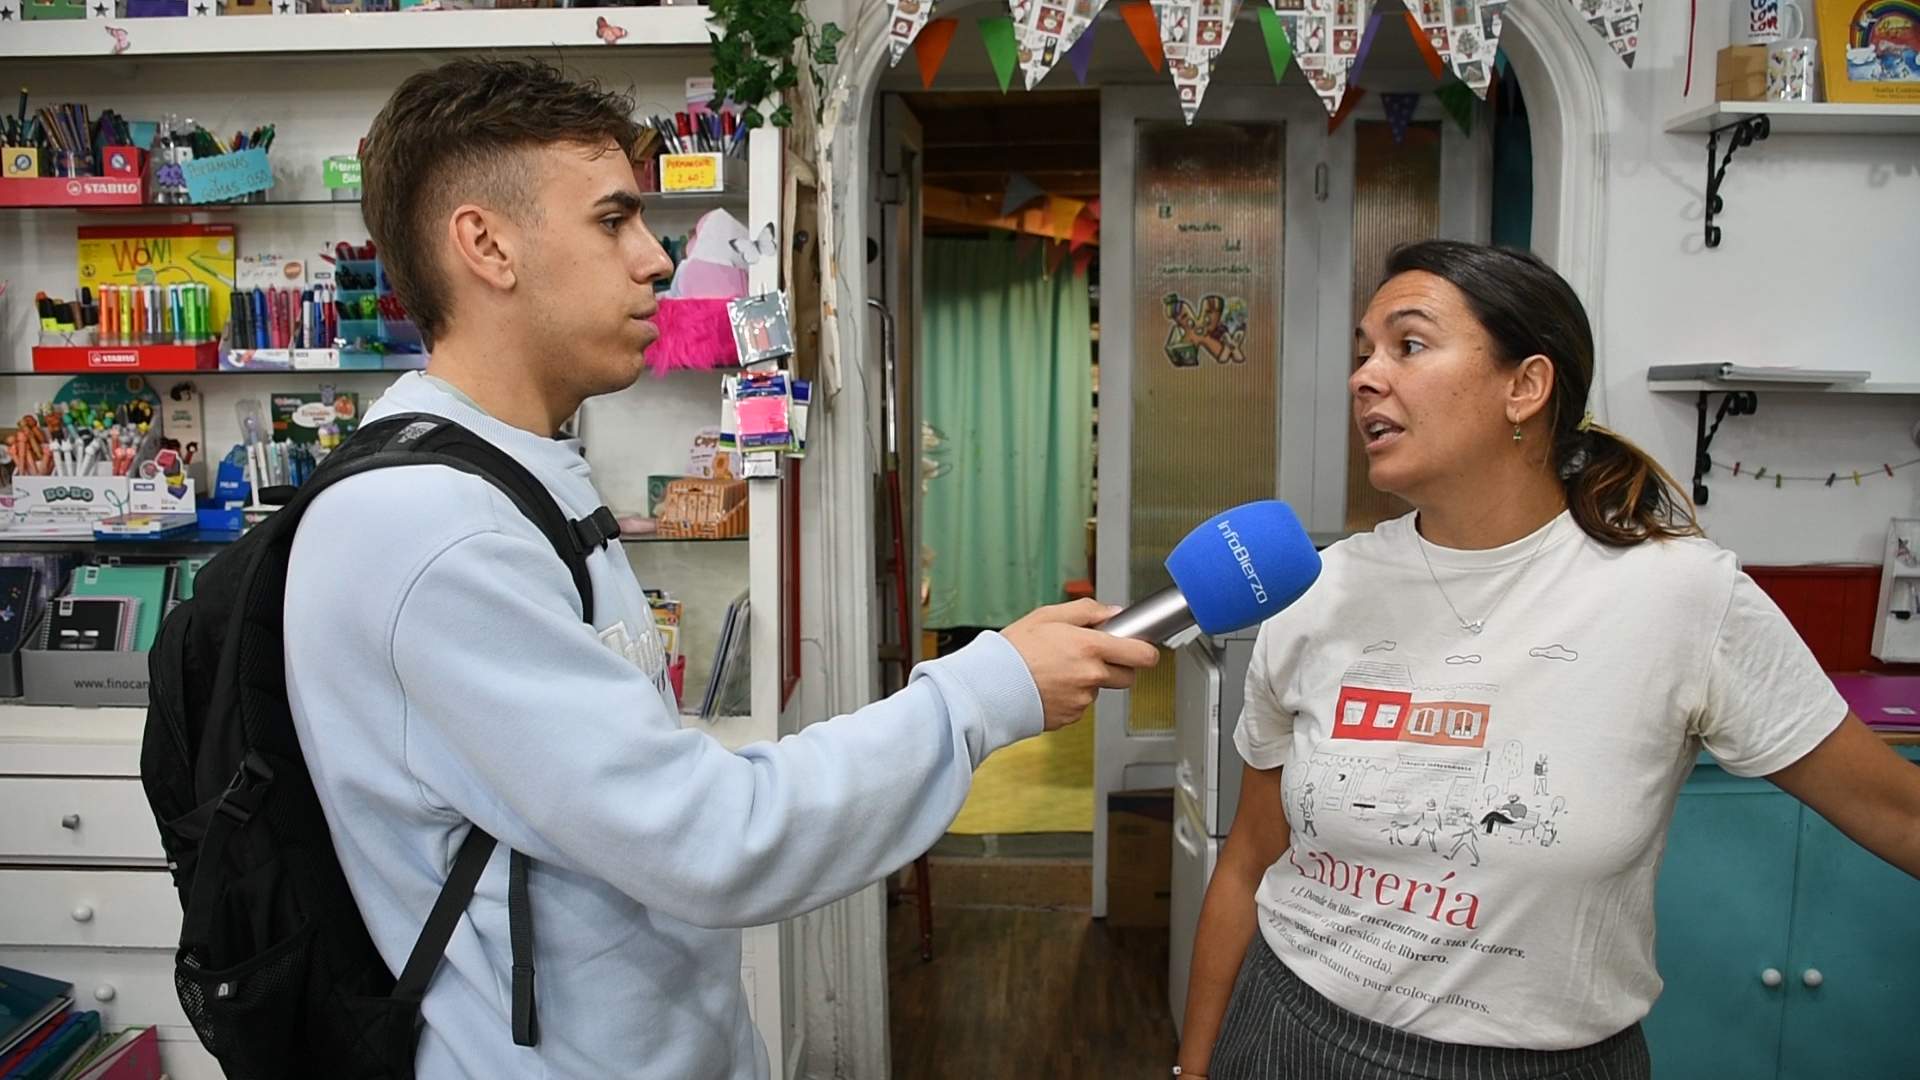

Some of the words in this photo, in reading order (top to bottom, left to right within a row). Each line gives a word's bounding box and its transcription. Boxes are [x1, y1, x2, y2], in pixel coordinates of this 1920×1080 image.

[84, 183, 138, 194] STABILO
[102, 353, 137, 363] STABILO
[1217, 520, 1268, 604] InfoBierzo
[1360, 912, 1429, 943] encuentran
[1430, 936, 1441, 945] a
[1443, 937, 1468, 948] sus
[1470, 938, 1527, 960] lectores.
[1352, 947, 1394, 976] tienda).
[1381, 939, 1397, 954] de
[1397, 943, 1450, 965] librero.
[1297, 942, 1319, 959] con
[1318, 952, 1361, 984] estantes
[1362, 974, 1393, 993] para
[1395, 983, 1443, 1005] colocar
